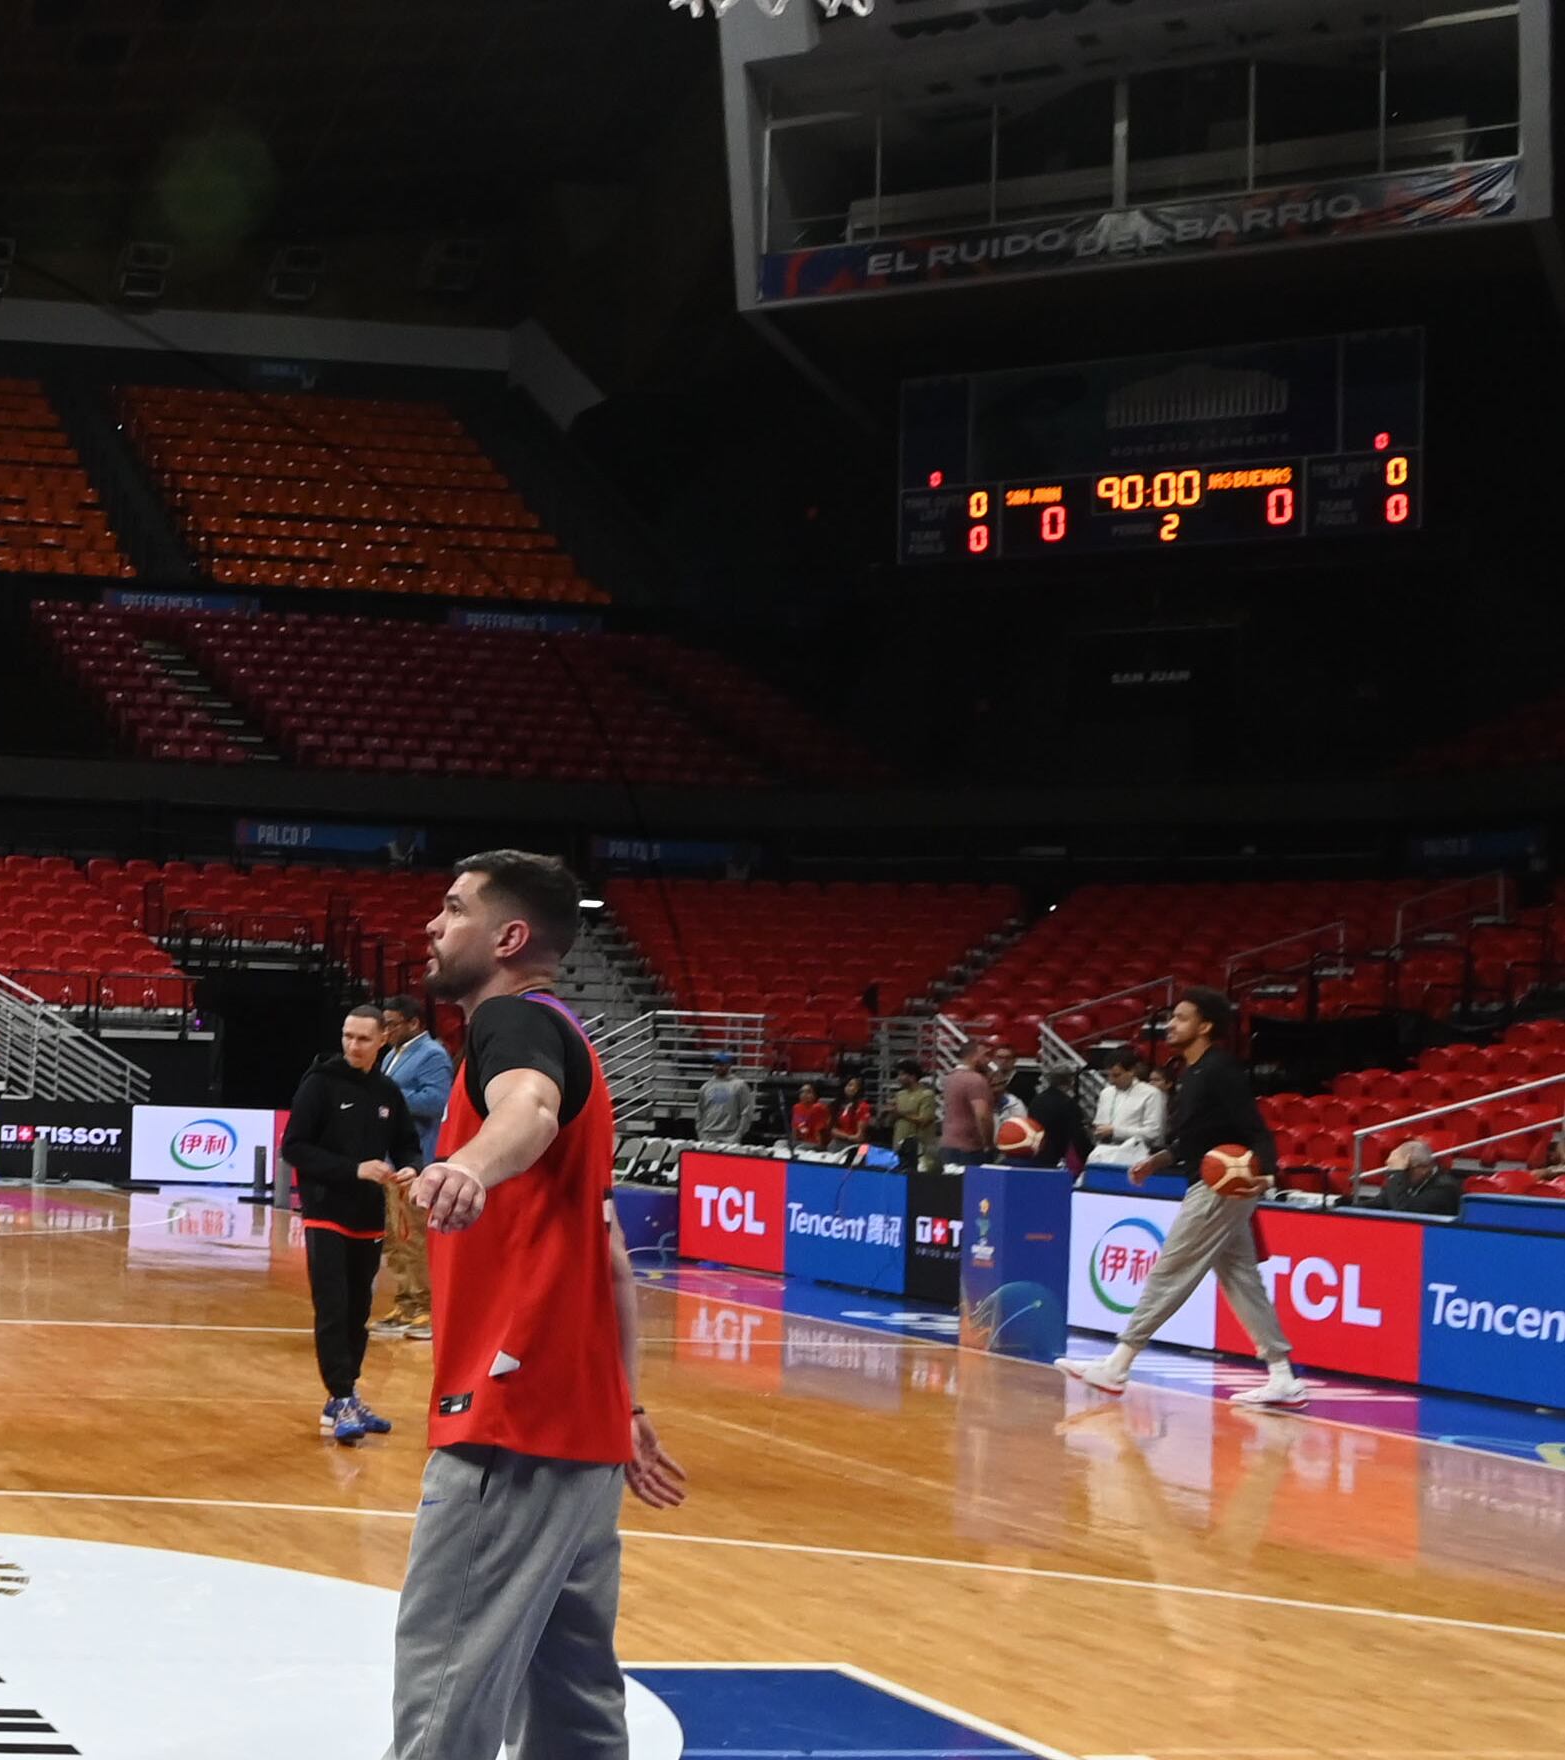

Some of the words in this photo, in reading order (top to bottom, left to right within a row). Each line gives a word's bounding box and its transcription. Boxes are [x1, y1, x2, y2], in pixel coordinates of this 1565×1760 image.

[867, 250, 919, 276] EL
[927, 226, 1069, 267] RUIDO
[1174, 193, 1362, 243] BARRIO
[1385, 455, 1409, 487] 0
[967, 489, 989, 520] 0
[1096, 468, 1203, 512] 90:00
[1266, 487, 1294, 526] 0
[1384, 491, 1410, 525] 0
[966, 523, 991, 555] 0
[1040, 504, 1066, 543] 0
[1158, 511, 1182, 543] 2
[257, 824, 298, 845] PALCO
[302, 827, 312, 844] P
[35, 1125, 122, 1146] TISSOT
[178, 1133, 230, 1157] 伊利
[694, 1185, 765, 1235] TCL
[787, 1203, 866, 1243] Tencent
[866, 1213, 901, 1247] 腾讯
[1099, 1244, 1160, 1286] 伊利
[1258, 1254, 1382, 1328] TCL
